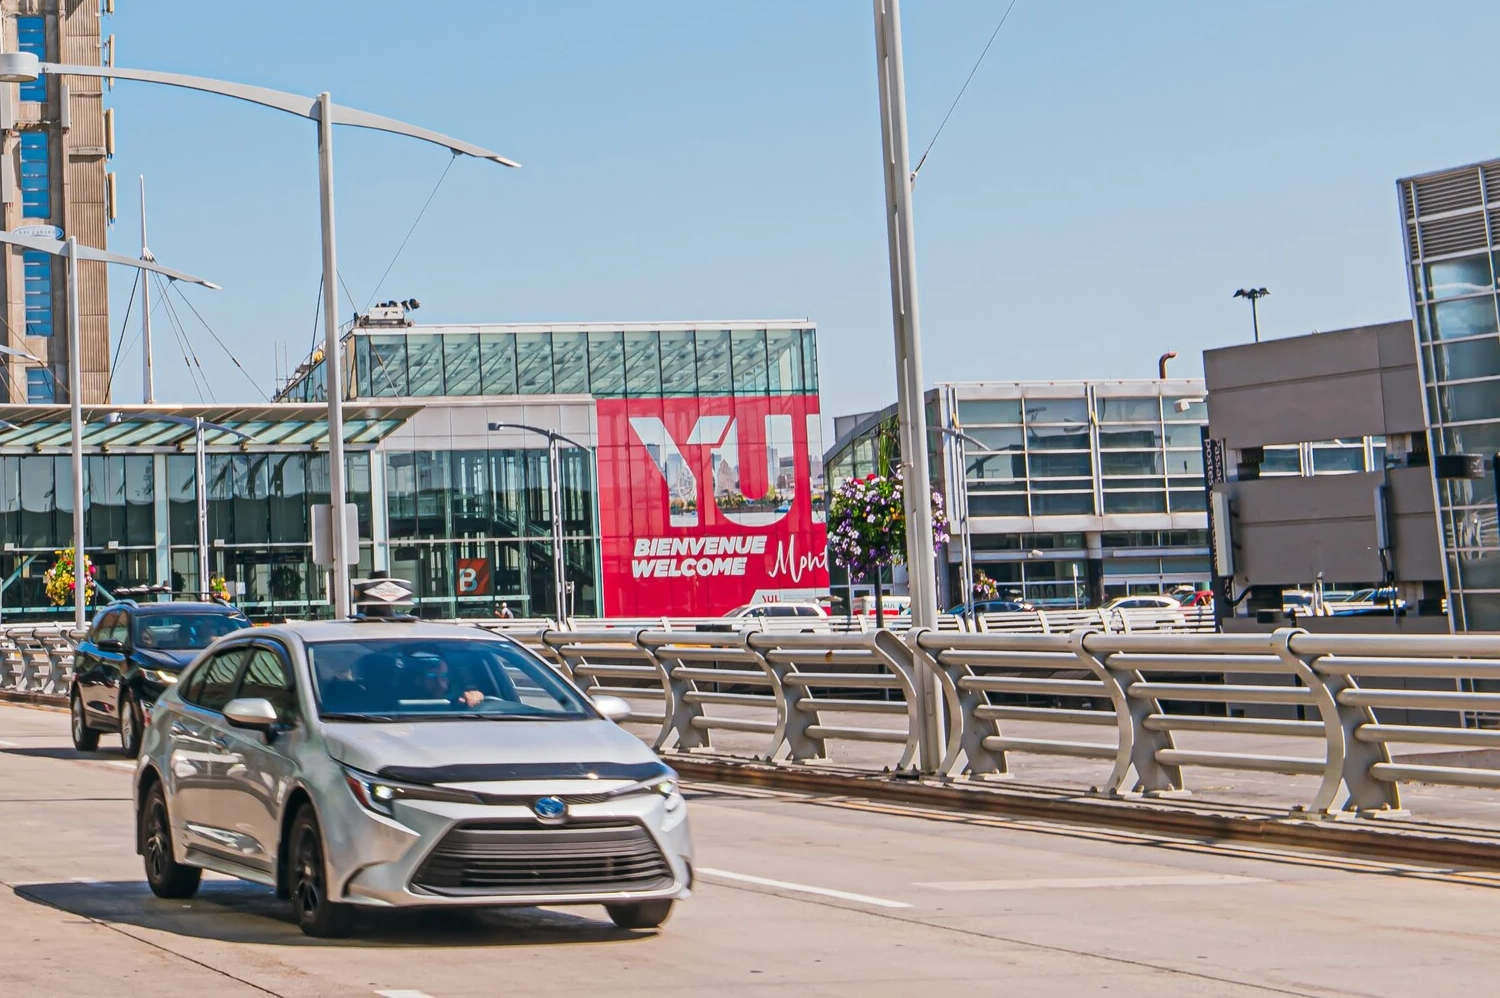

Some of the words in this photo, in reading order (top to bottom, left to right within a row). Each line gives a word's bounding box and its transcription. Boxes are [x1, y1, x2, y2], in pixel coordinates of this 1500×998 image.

[633, 535, 768, 557] BIENVENUE
[631, 556, 748, 578] WELCOME
[459, 567, 478, 592] B
